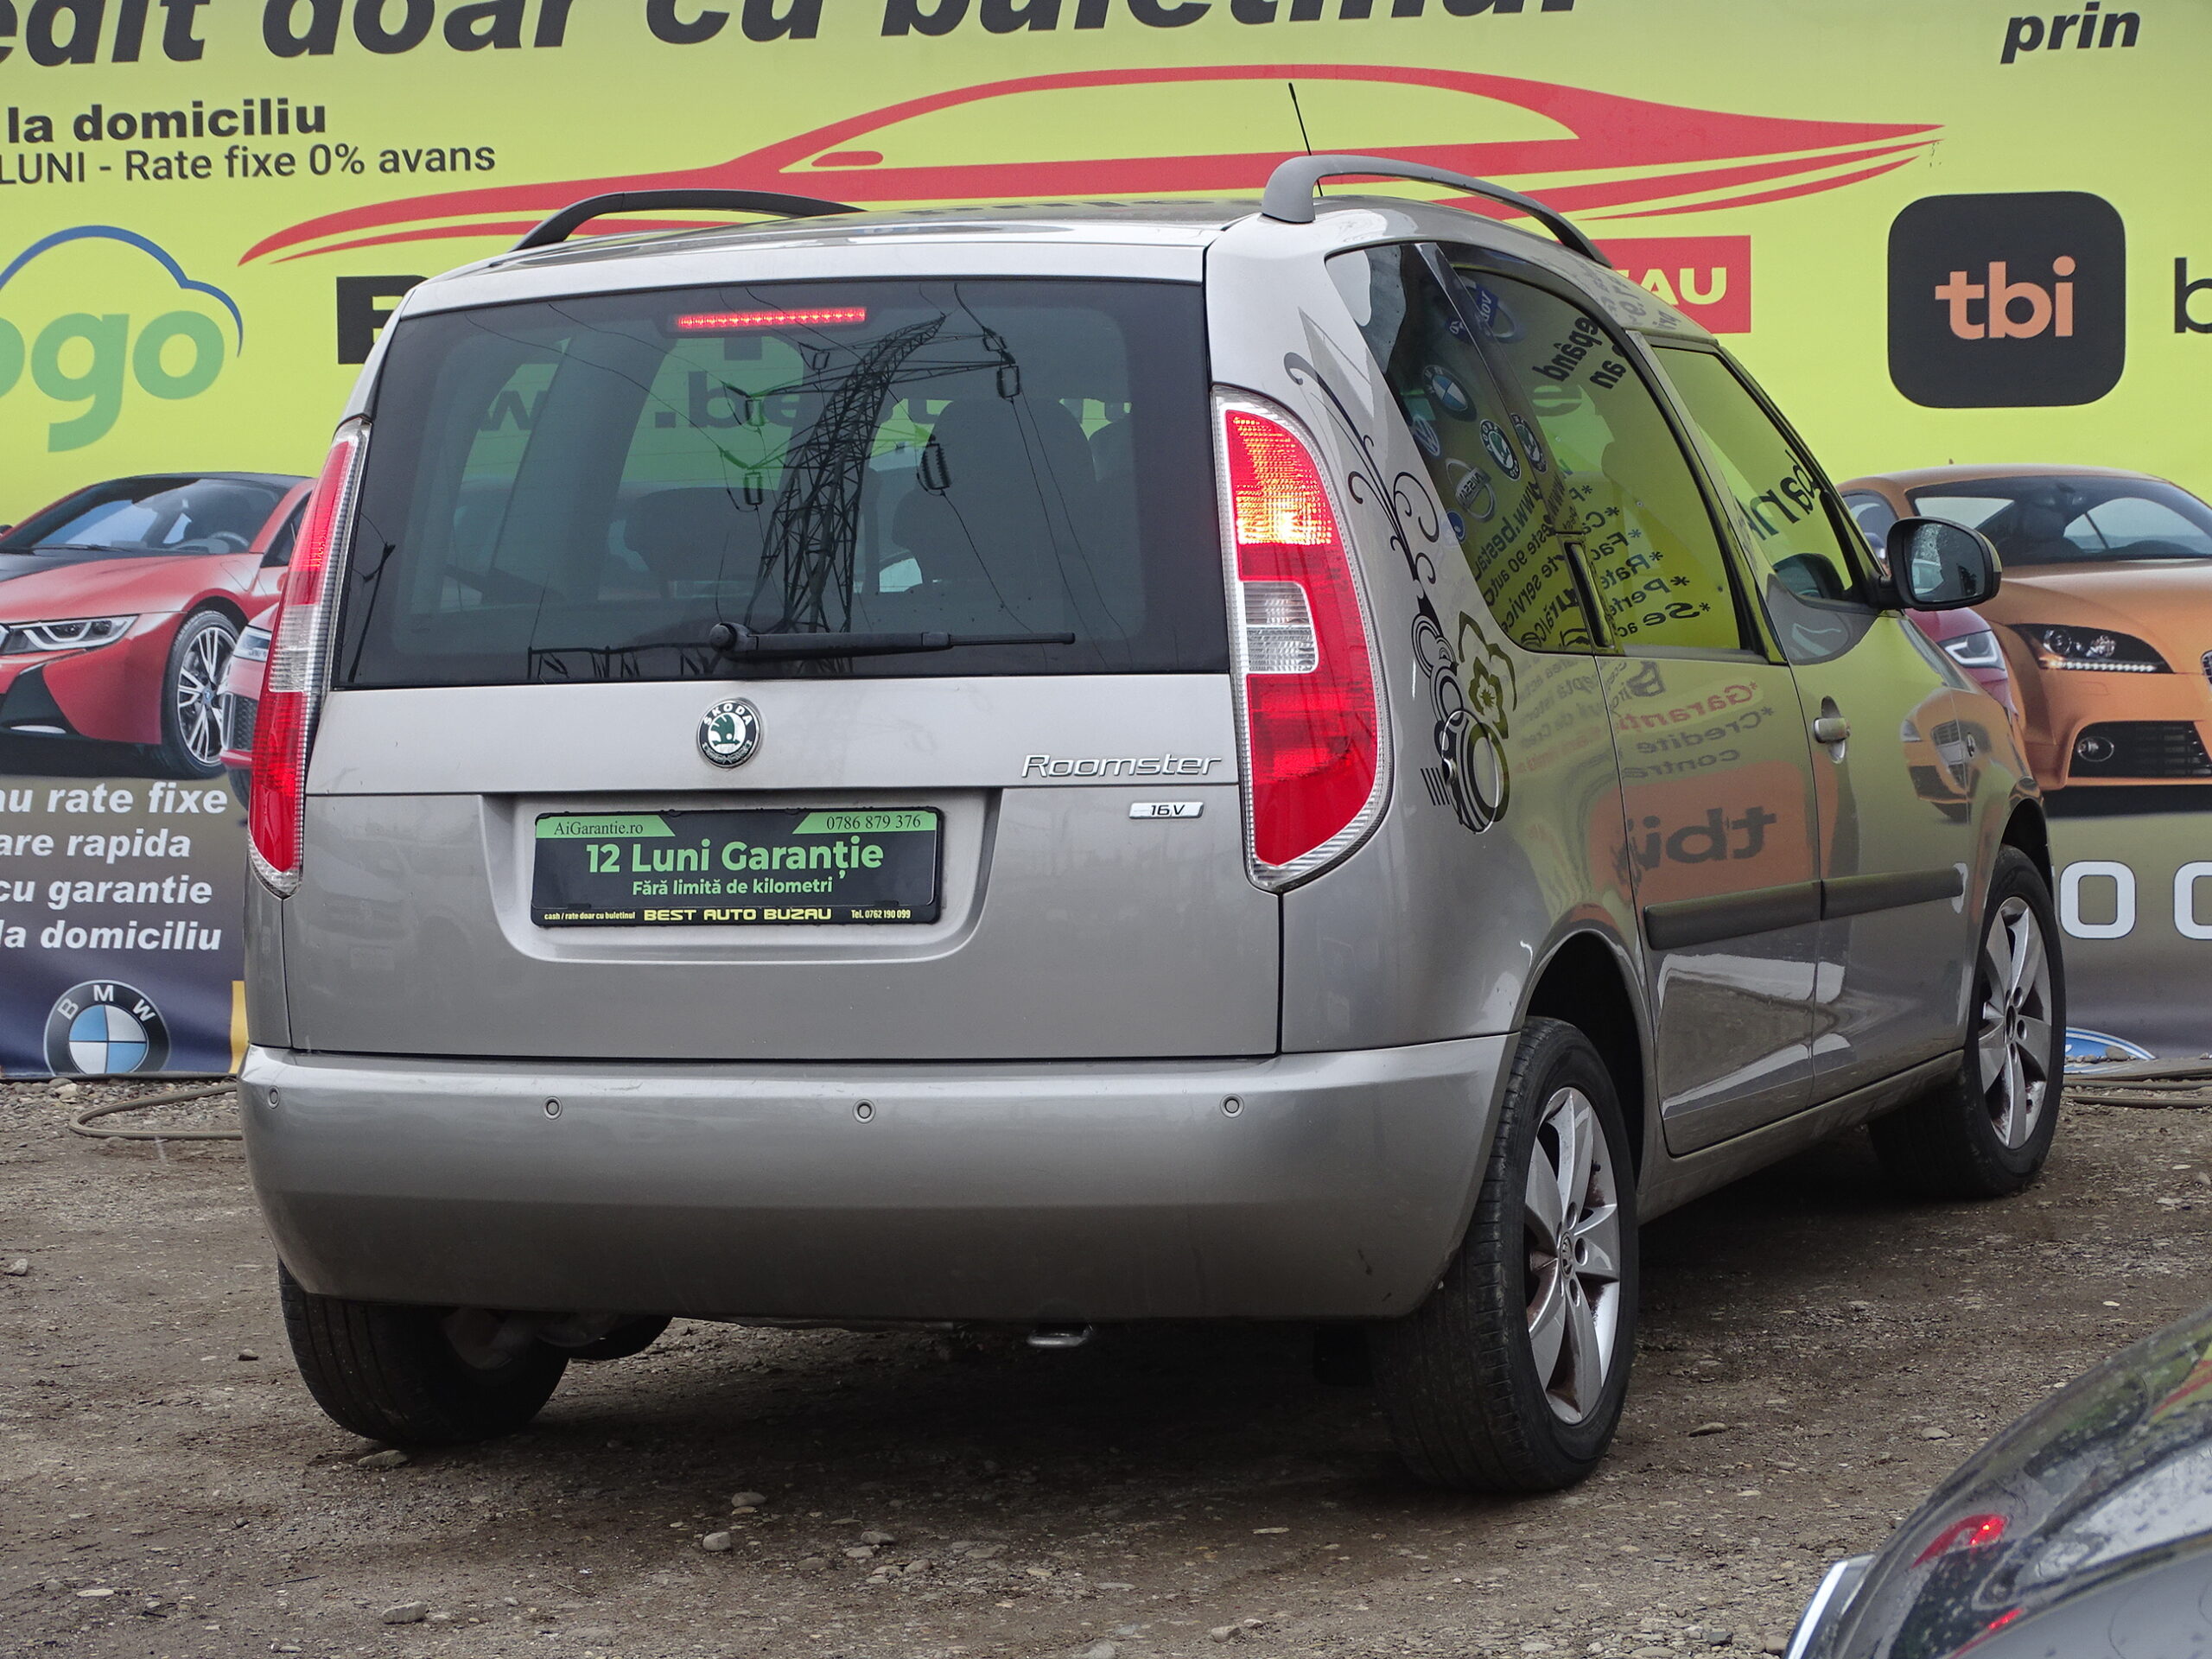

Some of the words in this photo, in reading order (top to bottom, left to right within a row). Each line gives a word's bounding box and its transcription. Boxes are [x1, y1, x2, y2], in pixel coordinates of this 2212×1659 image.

[2000, 1, 2141, 65] prin
[8, 106, 54, 143] la
[73, 97, 326, 142] domiciliu
[126, 149, 213, 181] Rate
[225, 143, 296, 178] fixe
[309, 143, 365, 175] 0%
[378, 146, 496, 174] avans
[1616, 266, 1727, 305] AU
[1935, 256, 2076, 340] tbi
[1021, 753, 1222, 778] Roomster
[47, 783, 134, 814] rate
[149, 781, 227, 814] fixe
[1151, 804, 1185, 816] 16V
[554, 822, 644, 836] AiGarantie.ro
[826, 816, 861, 830] 0786
[865, 815, 891, 830] 879
[895, 814, 921, 829] 376
[67, 828, 191, 864] rapida
[586, 842, 620, 873] 12
[632, 838, 711, 873] Luni
[48, 874, 213, 911] garantie
[632, 880, 668, 896] Fără
[673, 879, 721, 895] limită
[726, 879, 748, 893] de
[753, 876, 833, 893] kilometri
[543, 912, 561, 920] cash
[644, 910, 696, 921] BEST
[703, 909, 757, 920] AUTO
[763, 908, 831, 920] BUZAU
[864, 910, 882, 919] 0762
[41, 919, 222, 950] domiciliu
[57, 983, 156, 1021] BMW
